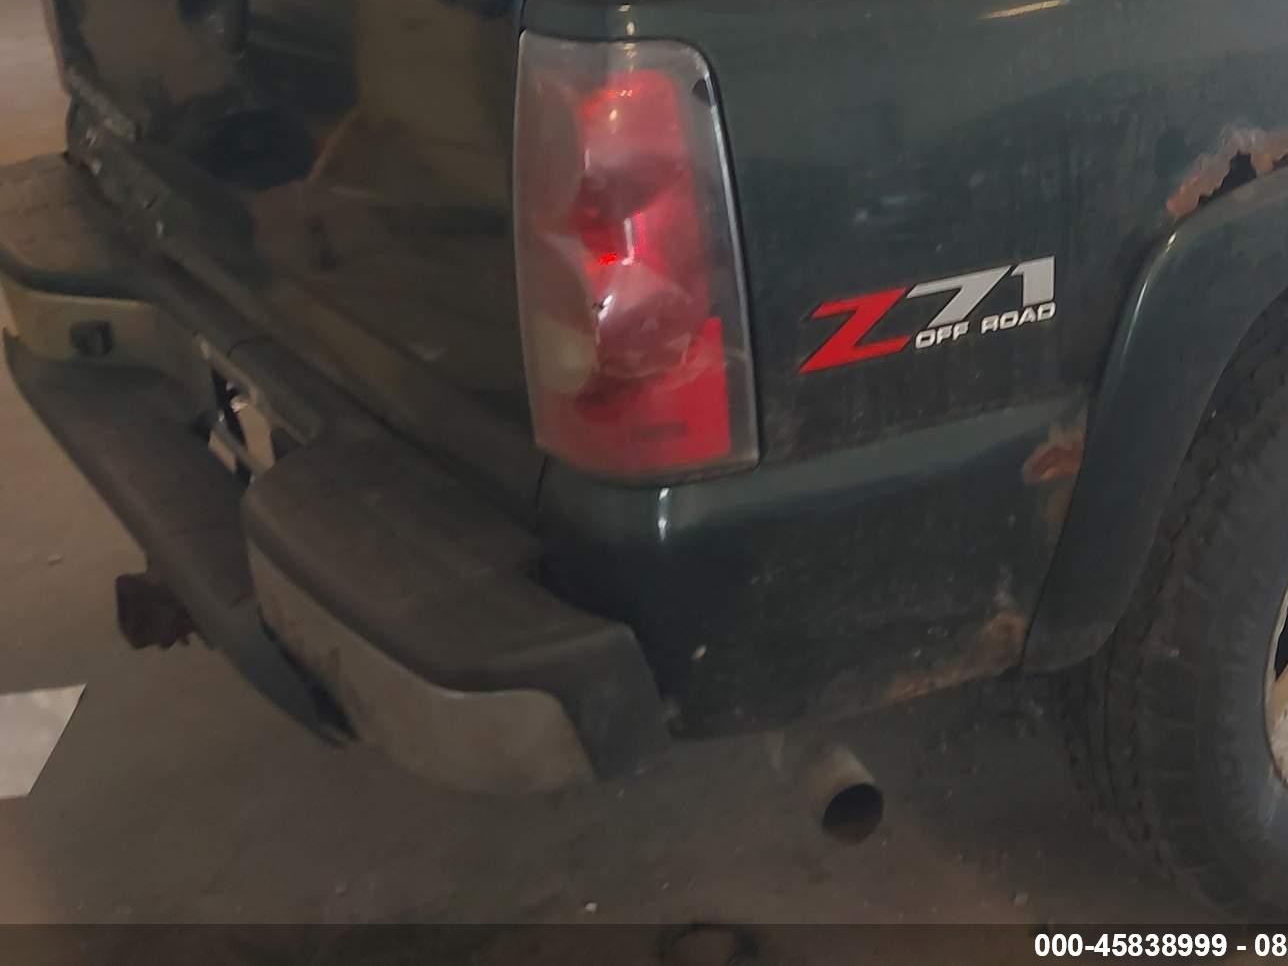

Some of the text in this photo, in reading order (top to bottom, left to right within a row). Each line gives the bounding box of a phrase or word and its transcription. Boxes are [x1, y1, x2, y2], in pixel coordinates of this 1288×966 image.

[799, 256, 1055, 374] Z71
[915, 302, 1056, 349] OFF ROAD
